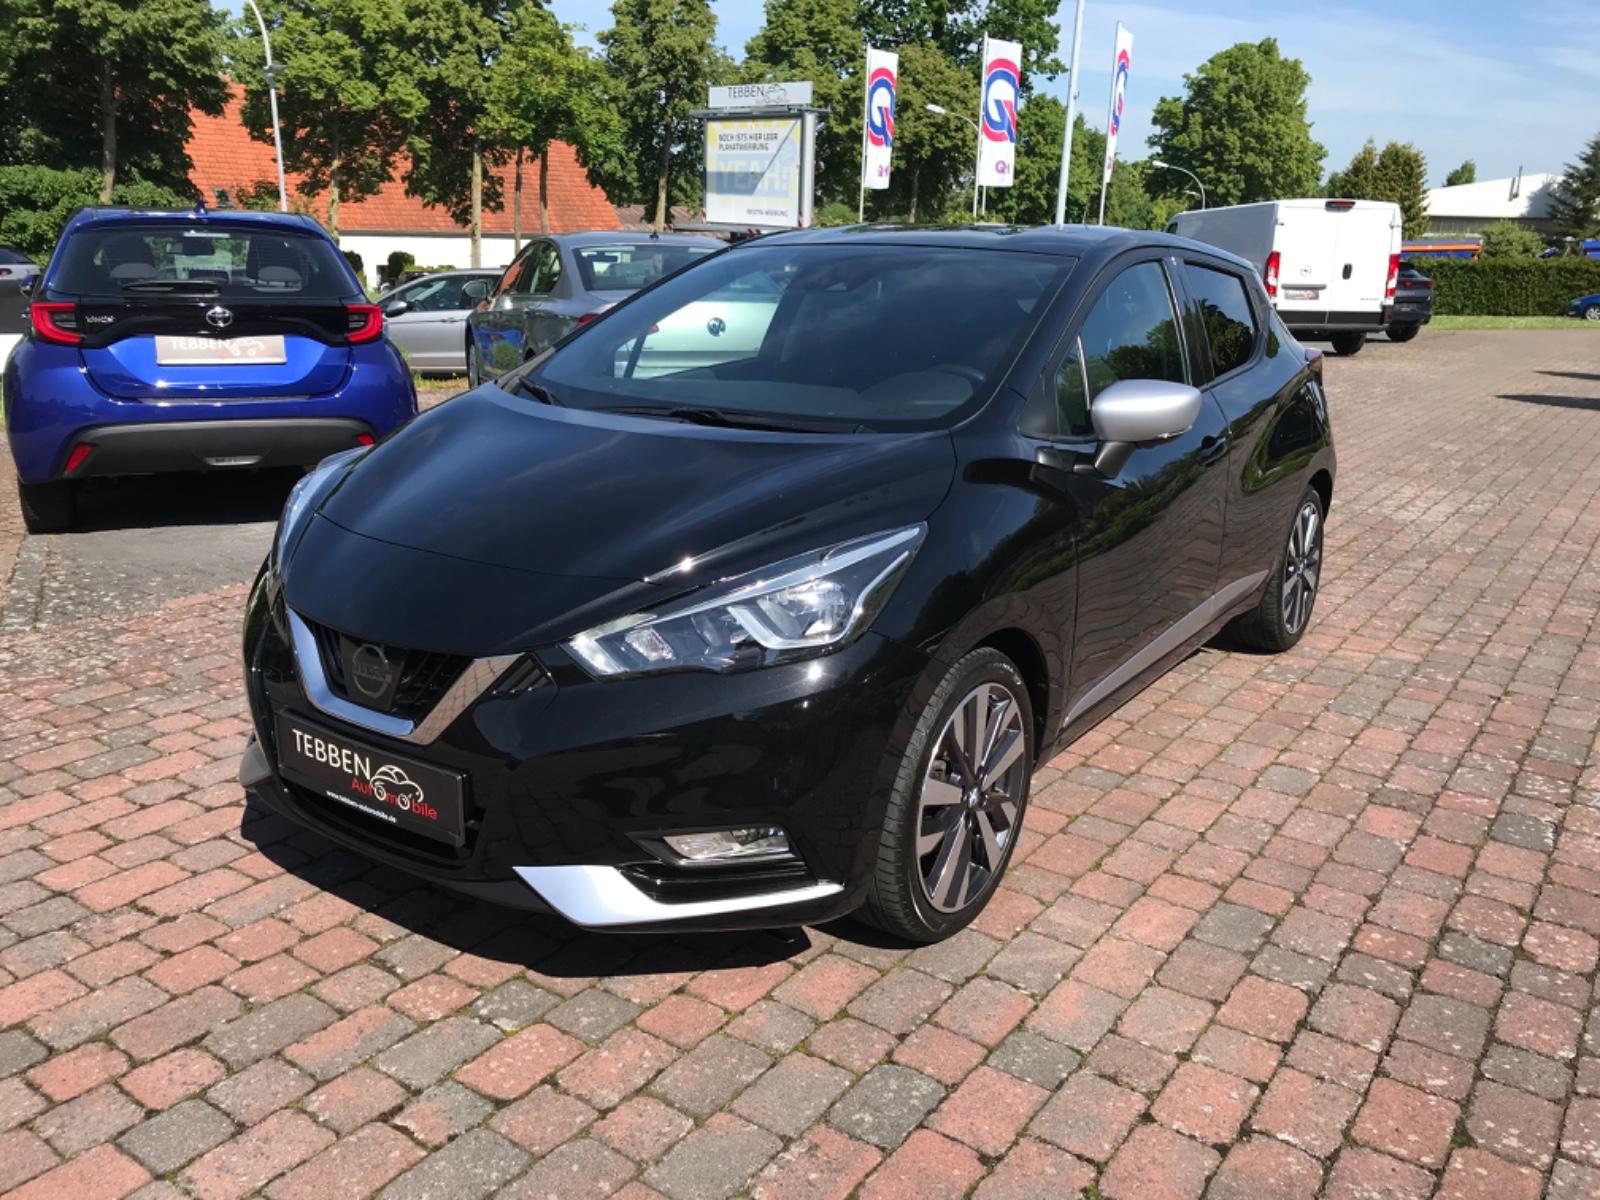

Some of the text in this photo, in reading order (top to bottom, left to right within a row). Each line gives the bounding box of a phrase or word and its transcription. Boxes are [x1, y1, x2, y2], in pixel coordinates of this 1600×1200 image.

[728, 86, 765, 98] TEBBEN
[171, 338, 230, 351] TEBBEN
[292, 728, 371, 780] TEBBEN
